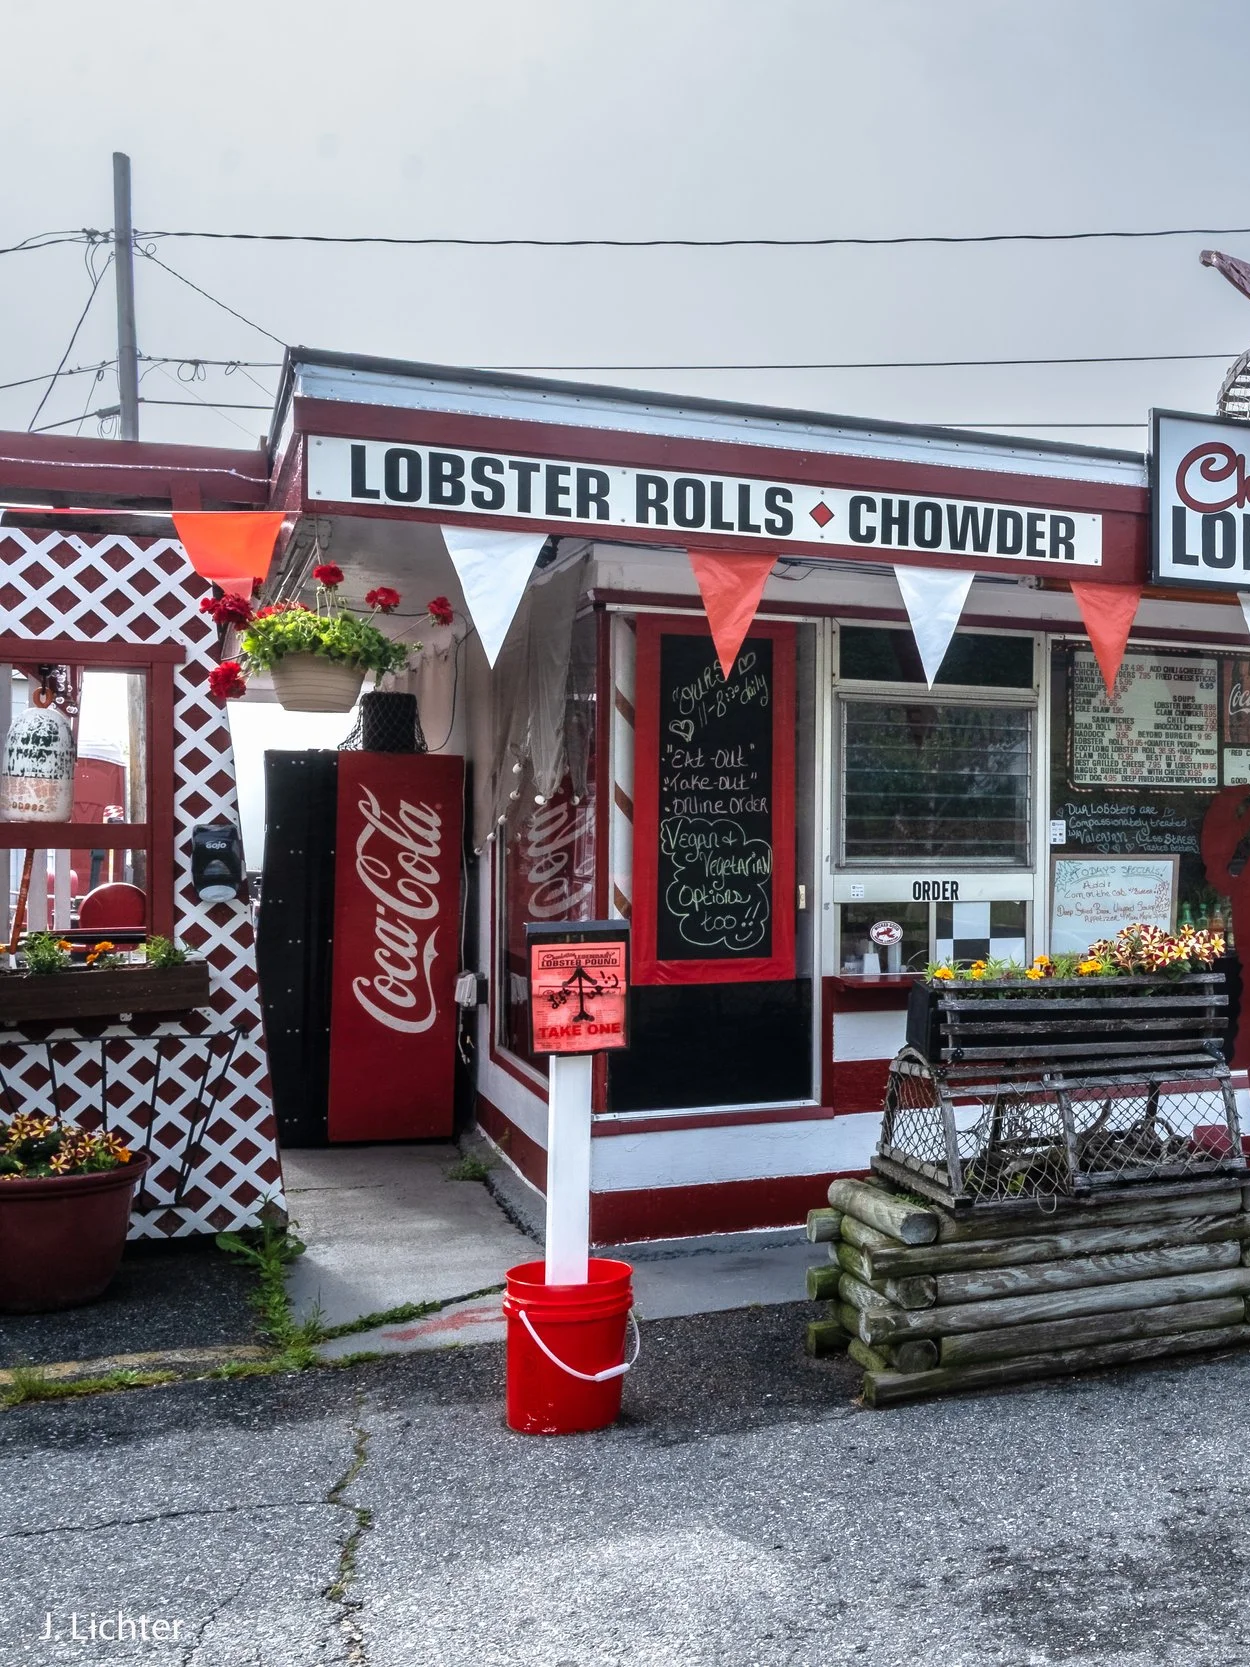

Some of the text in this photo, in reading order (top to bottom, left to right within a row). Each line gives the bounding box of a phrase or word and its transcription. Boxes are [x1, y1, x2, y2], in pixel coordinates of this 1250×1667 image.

[350, 444, 1076, 561] LOBSTER ROLLS CHOWDER
[1092, 716, 1134, 724] SANDWICHES
[912, 880, 959, 900] ORDER
[352, 783, 442, 1033] Coca-Cola
[538, 1023, 621, 1038] TAKE ONE
